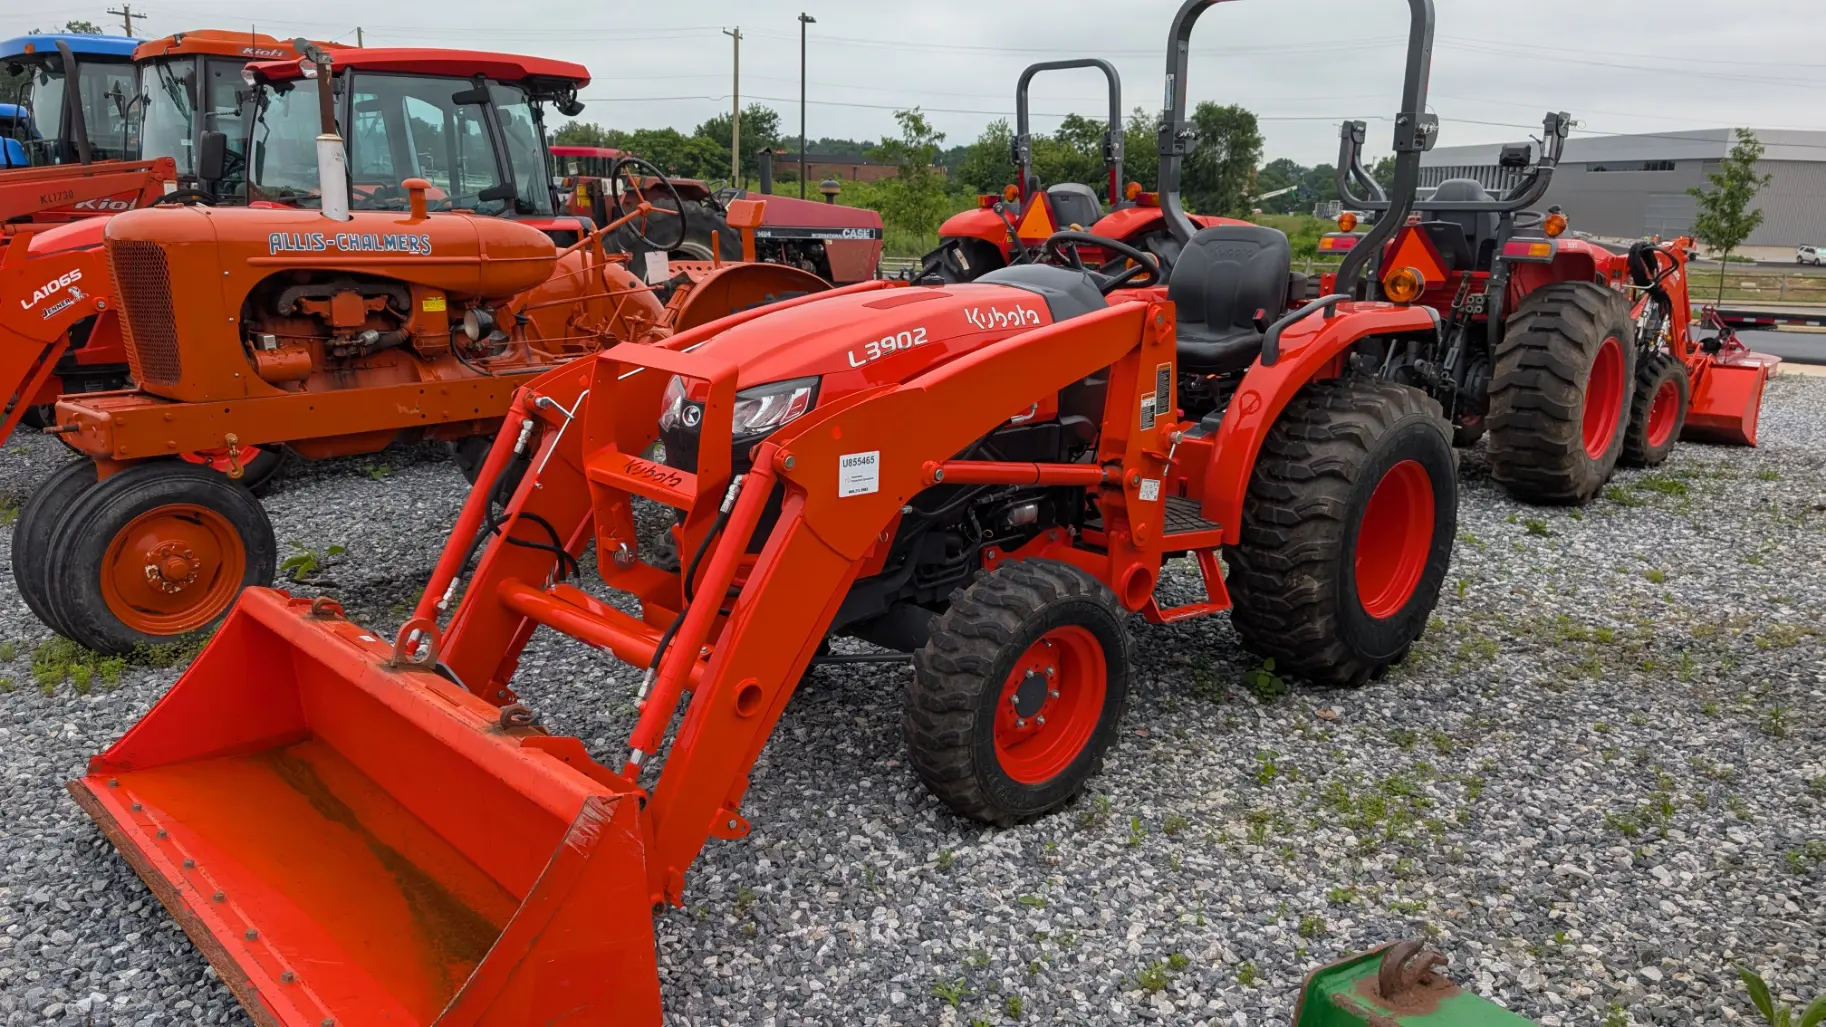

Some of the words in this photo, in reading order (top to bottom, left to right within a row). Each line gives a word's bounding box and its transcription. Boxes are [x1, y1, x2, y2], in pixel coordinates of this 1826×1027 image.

[40, 189, 75, 205] KL1730
[74, 198, 138, 211] Kiot
[269, 232, 432, 255] ALLIS-CHALMERS
[842, 228, 871, 239] CASE
[20, 268, 82, 310] LA1065
[43, 298, 71, 318] JENNER
[964, 304, 1041, 330] Kubota
[847, 327, 929, 369] L3902
[842, 455, 875, 468] U855465
[624, 459, 683, 488] Kubota
